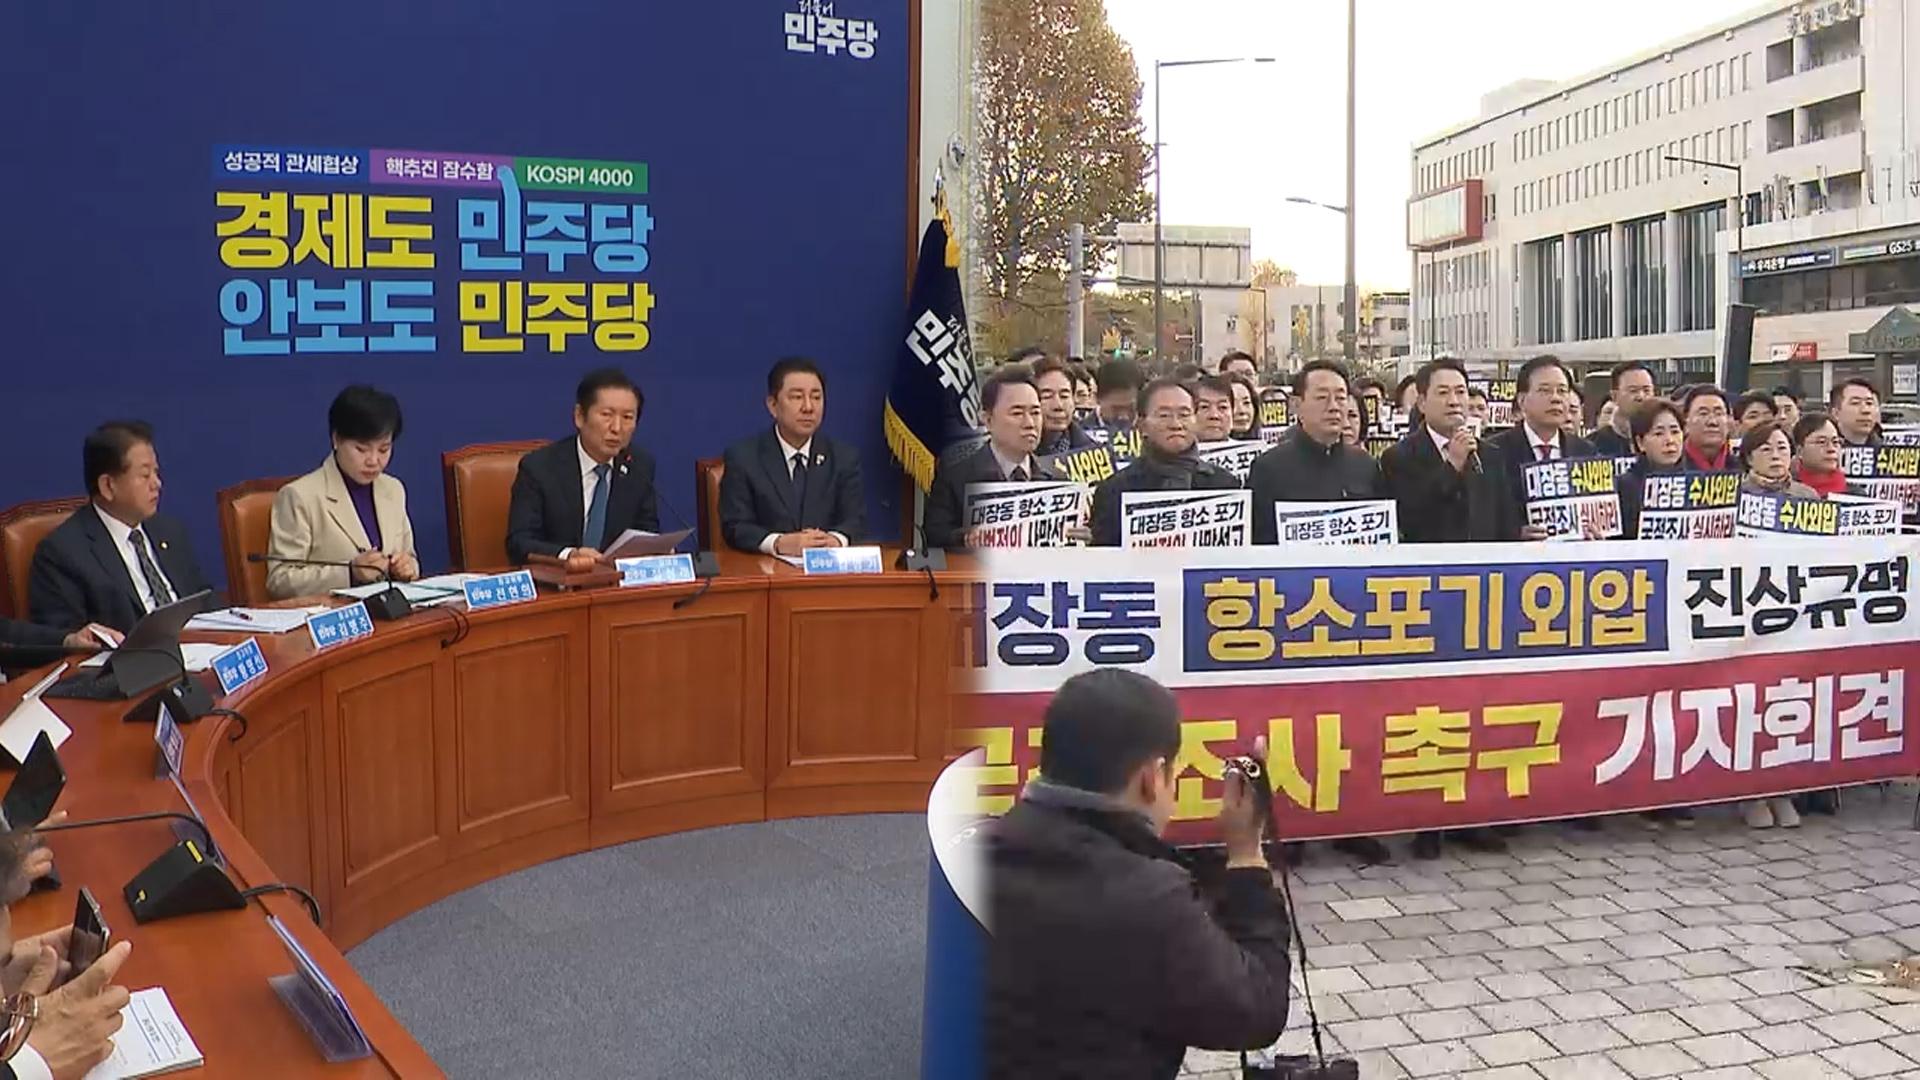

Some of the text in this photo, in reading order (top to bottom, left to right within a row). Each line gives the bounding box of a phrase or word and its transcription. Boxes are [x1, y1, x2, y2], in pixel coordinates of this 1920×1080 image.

[784, 12, 879, 59] 민주당
[224, 152, 359, 175] 성공적 관세협상
[386, 157, 493, 180] 핵추진 잠수함
[527, 165, 633, 187] KOSPI 4000
[215, 166, 655, 272] 경제도 민주당
[218, 278, 655, 355] 안보도 민주당
[1525, 462, 1569, 498] 대장동
[1571, 458, 1614, 493] 수사외압
[1644, 474, 1738, 509] 대장동 수사외압
[971, 492, 1080, 525] 대장동 항소 포기
[1130, 500, 1245, 536] 대장동 항소 포기
[1285, 520, 1325, 541] 대장동
[1329, 515, 1357, 537] 항소
[1361, 510, 1390, 532] 포기
[1739, 492, 1839, 535] 대장동 수사외압
[1684, 556, 1909, 641] 진상규명
[1381, 702, 1563, 802] 촉구
[1594, 668, 1905, 786] 기자회견
